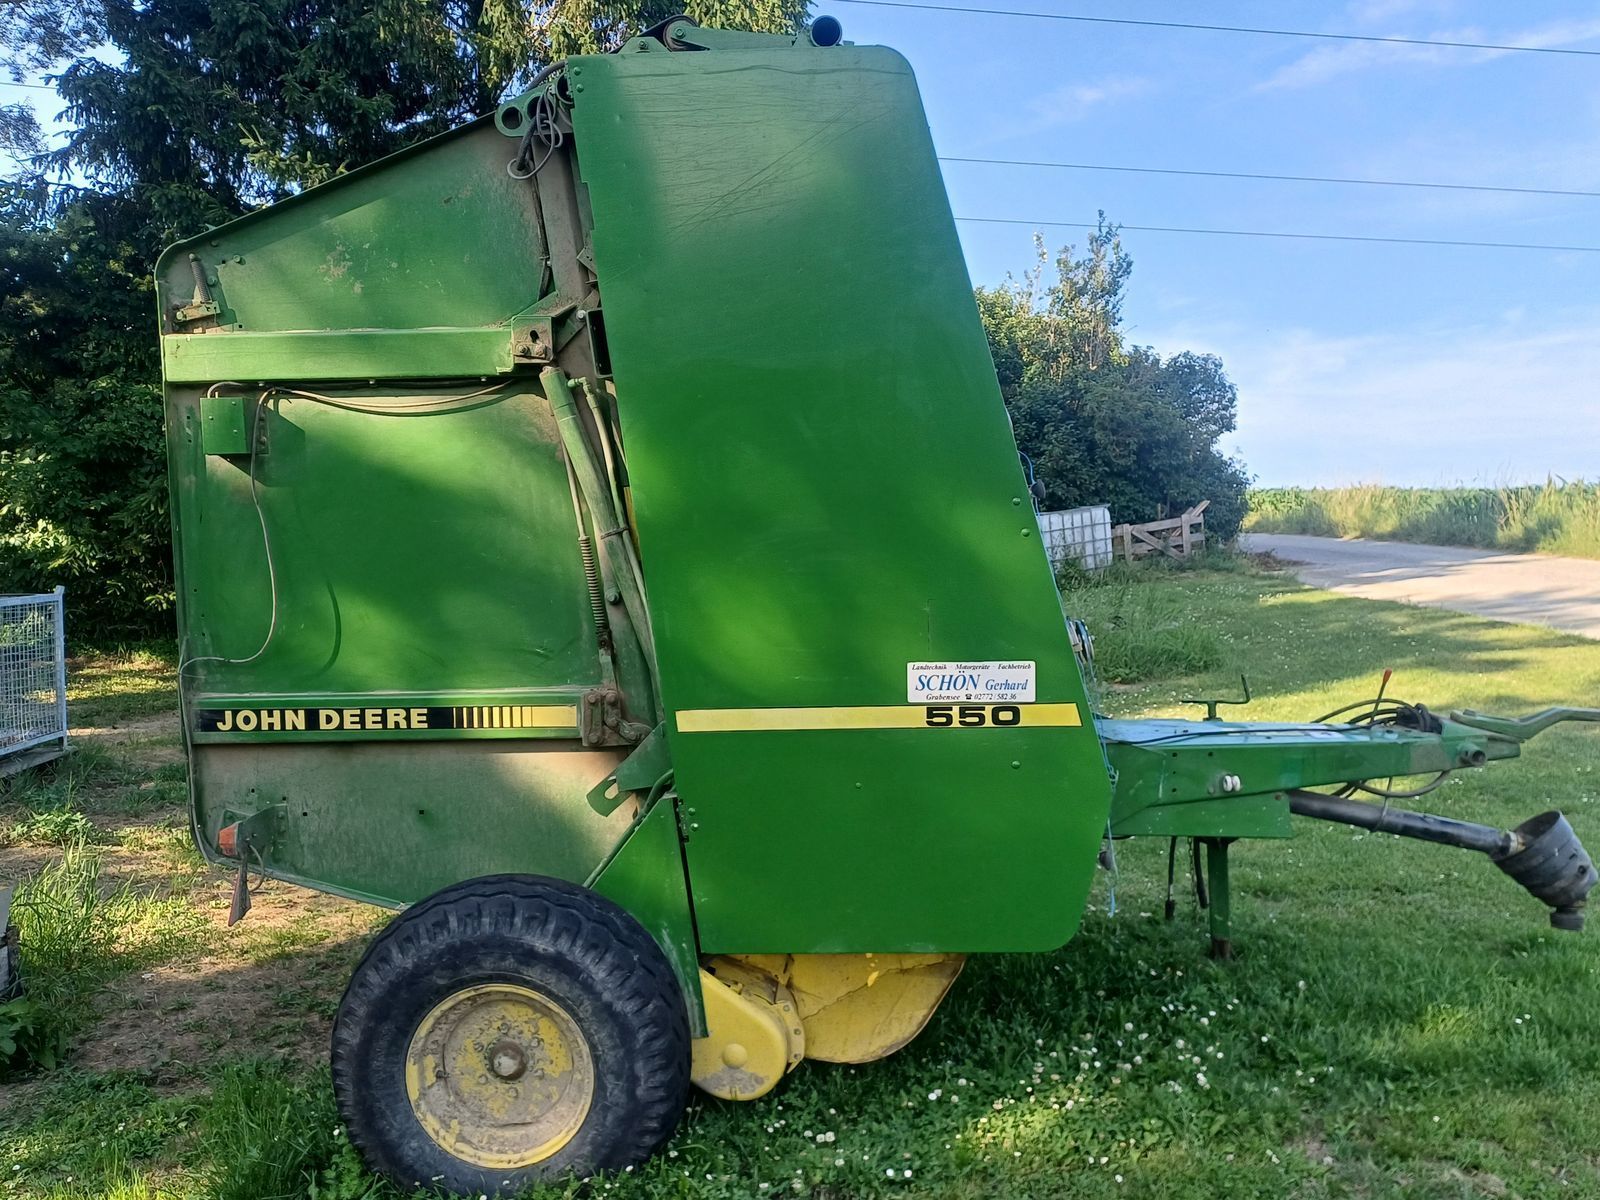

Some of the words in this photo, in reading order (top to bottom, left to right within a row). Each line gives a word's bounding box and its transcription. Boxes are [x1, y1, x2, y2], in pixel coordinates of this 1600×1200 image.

[915, 670, 981, 691] SCHÖN
[985, 679, 1029, 690] Gerhard
[216, 709, 306, 731] JOHN
[319, 708, 429, 730] DEERE
[926, 705, 1021, 727] 550
